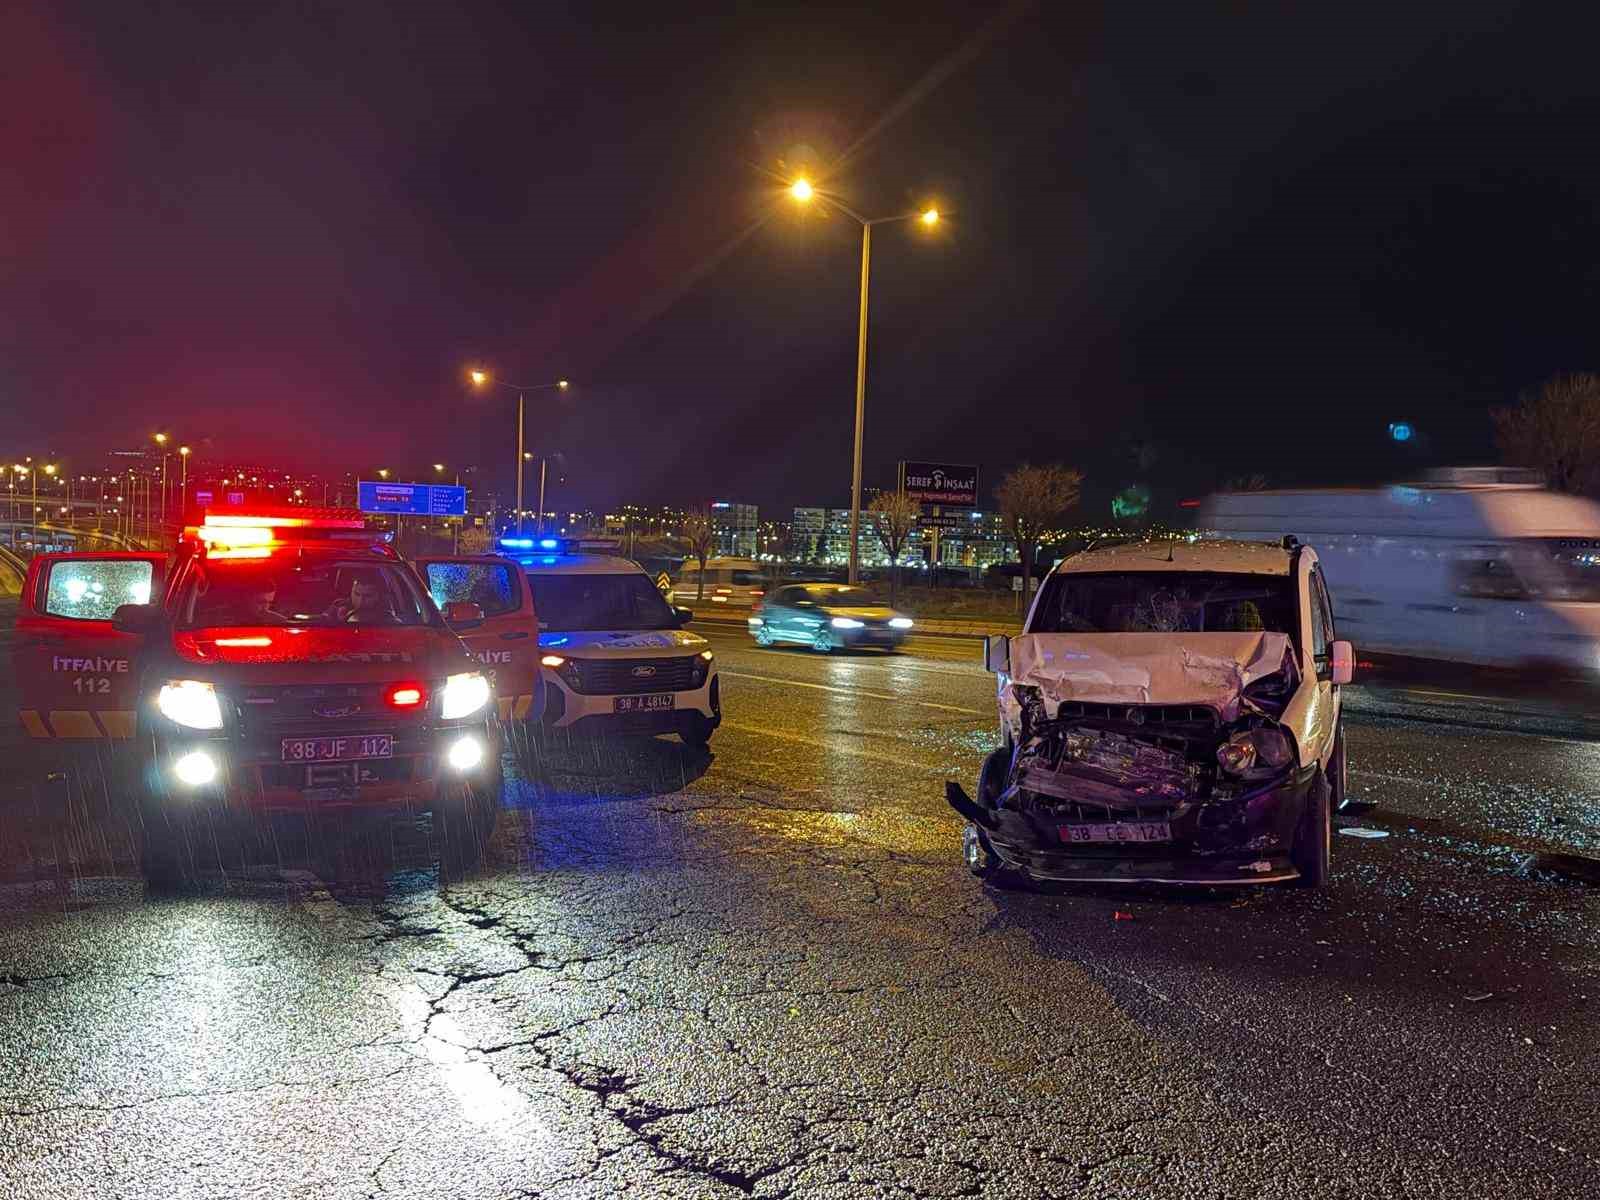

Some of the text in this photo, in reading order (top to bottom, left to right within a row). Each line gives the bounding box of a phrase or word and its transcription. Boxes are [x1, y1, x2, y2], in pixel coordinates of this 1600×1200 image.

[73, 677, 111, 694] 112
[293, 738, 389, 759] 38 JF 112
[1071, 827, 1090, 840] 38
